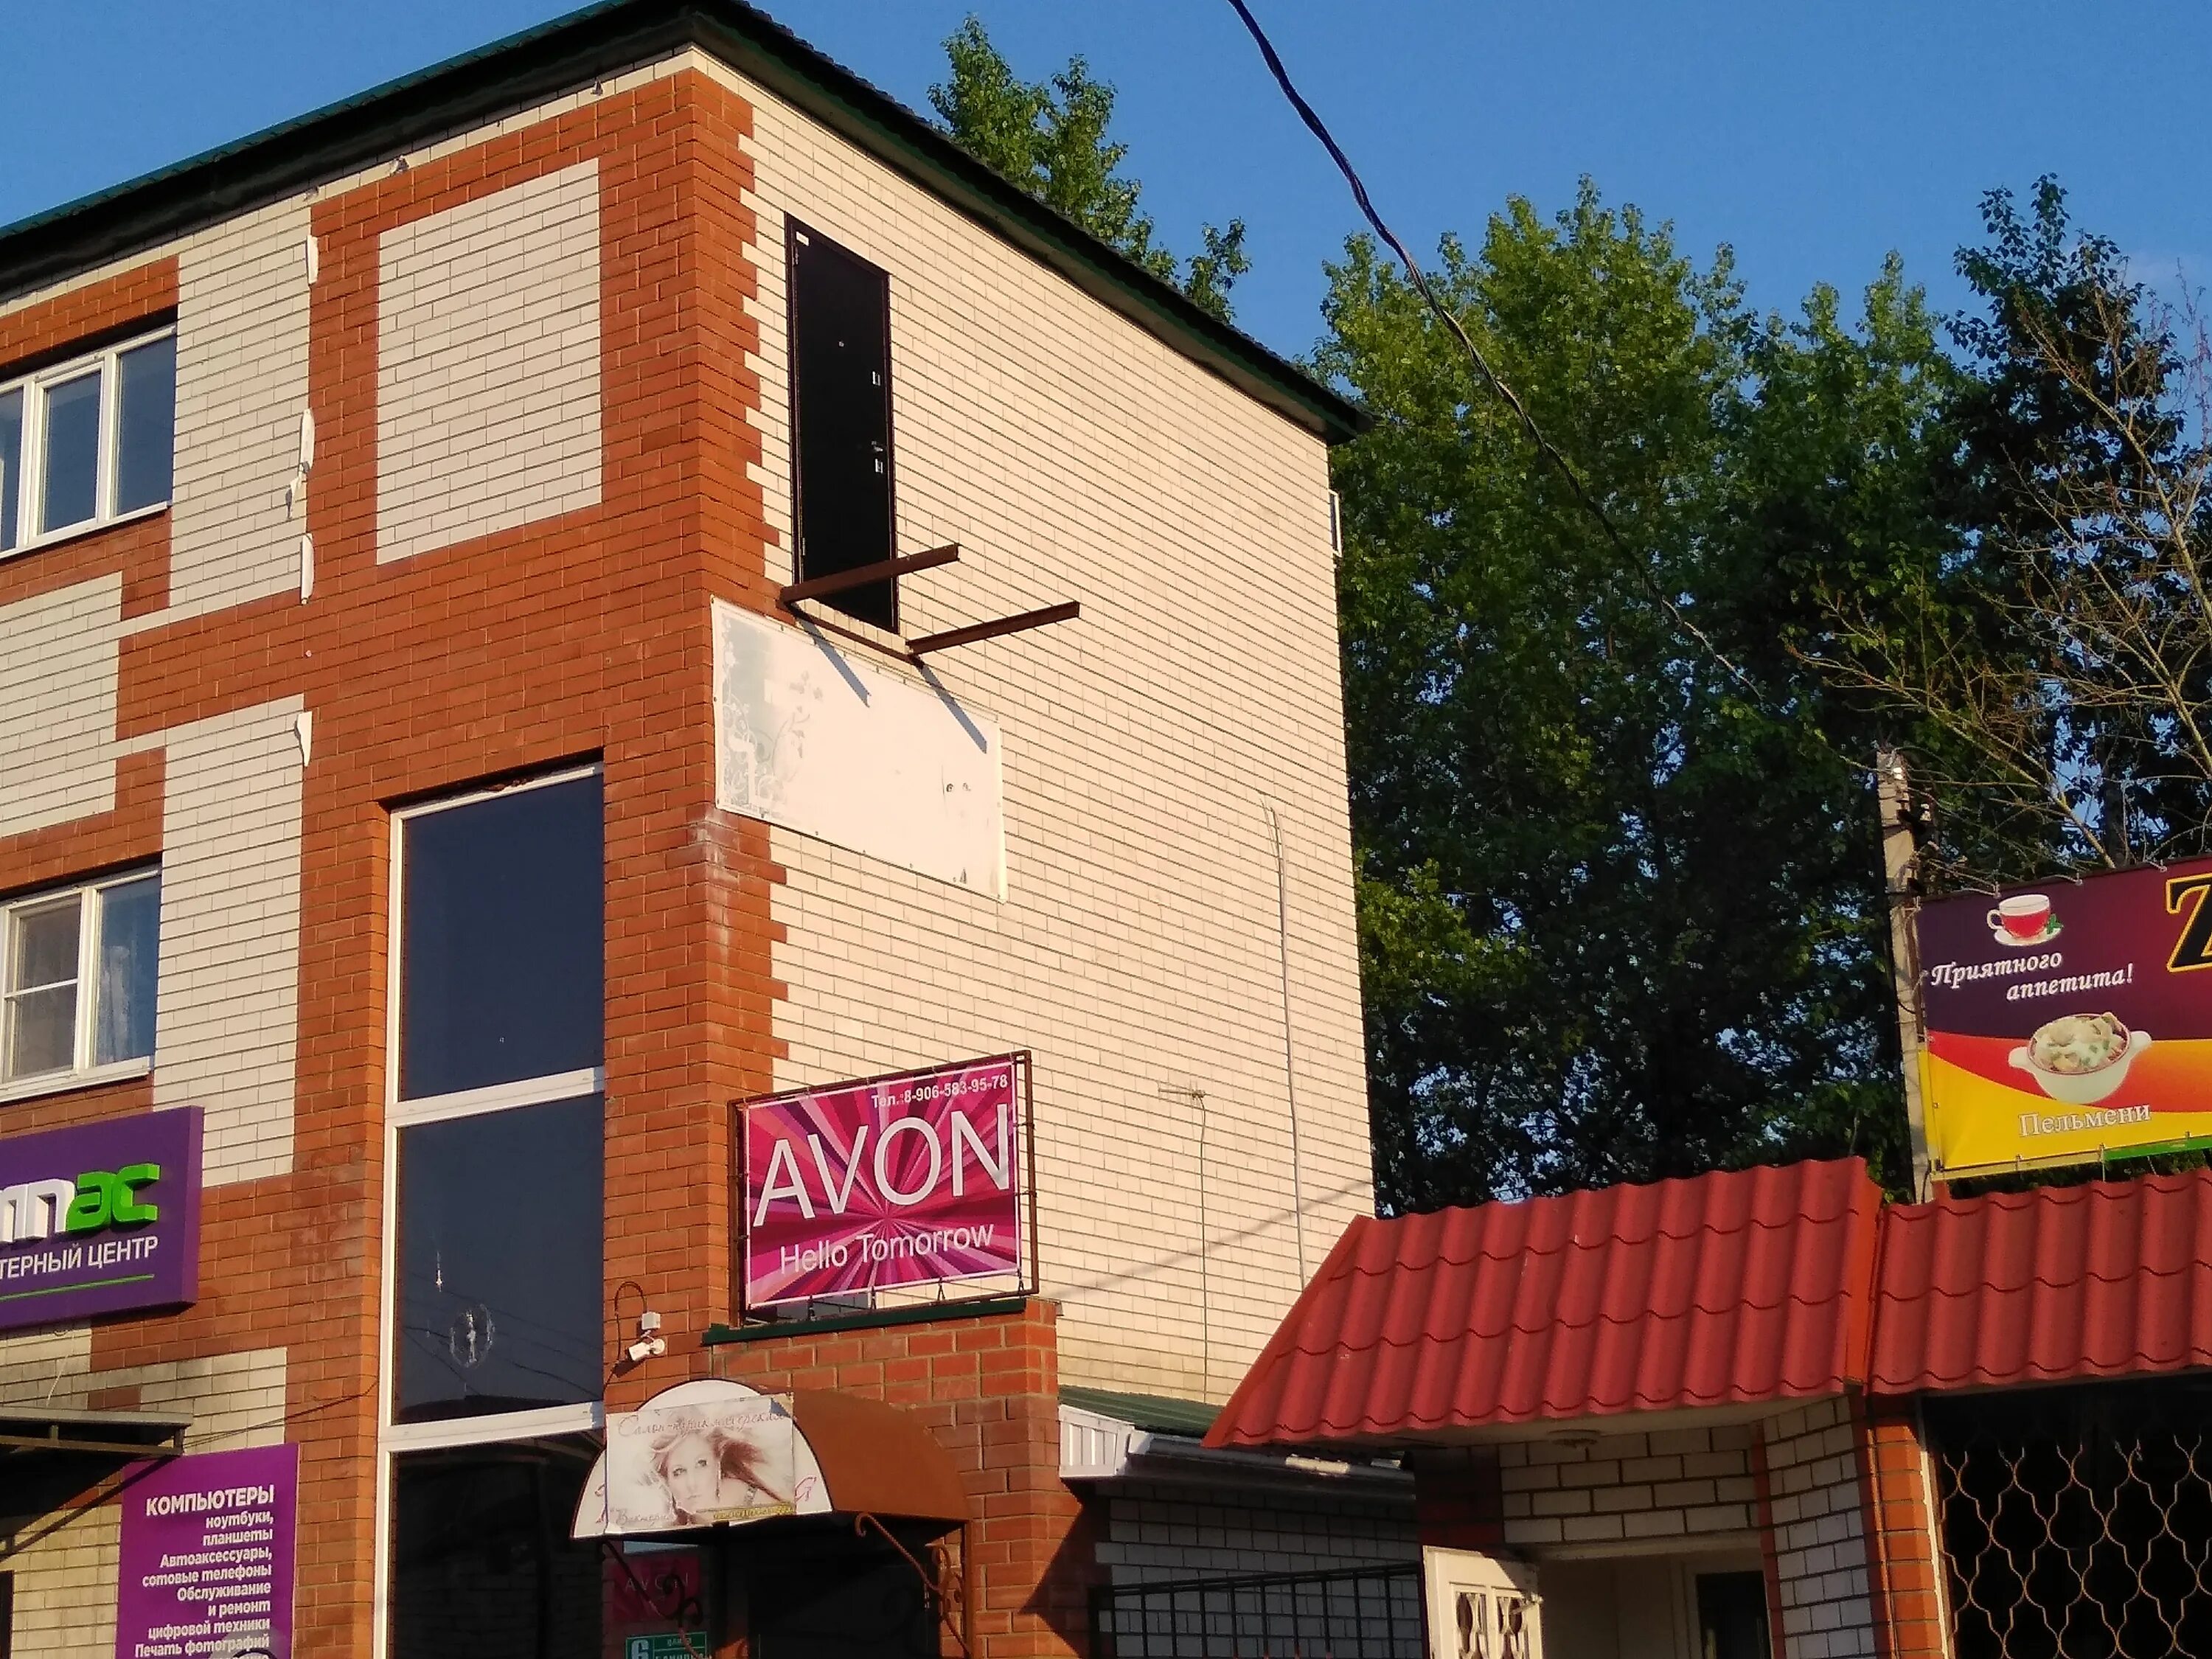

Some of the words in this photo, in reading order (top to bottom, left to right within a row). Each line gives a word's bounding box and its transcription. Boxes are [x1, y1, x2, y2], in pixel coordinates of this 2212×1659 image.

[1930, 952, 2062, 990] Приятного
[2006, 963, 2134, 1001] аппетита!
[2018, 1104, 2151, 1137] Пельмени
[753, 1103, 1011, 1228] AVON
[88, 1236, 159, 1269] ЦЕНТР
[780, 1238, 848, 1275] Hello
[856, 1223, 995, 1263] Tomorrow
[146, 1484, 274, 1516] КОМПЬЮТЕРЫ
[206, 1511, 274, 1528] ноутбуки,
[203, 1528, 273, 1546] планшеты
[160, 1546, 272, 1568] Автоаксессуары,
[142, 1571, 199, 1587] сотовые
[201, 1563, 271, 1582] телефоны
[177, 1581, 271, 1601] Обслуживание
[208, 1605, 216, 1616] и
[219, 1600, 271, 1618] ремонт
[148, 1620, 211, 1640] цифровой
[213, 1618, 271, 1633] техники
[135, 1643, 182, 1658] Печать
[184, 1633, 270, 1656] фотографий
